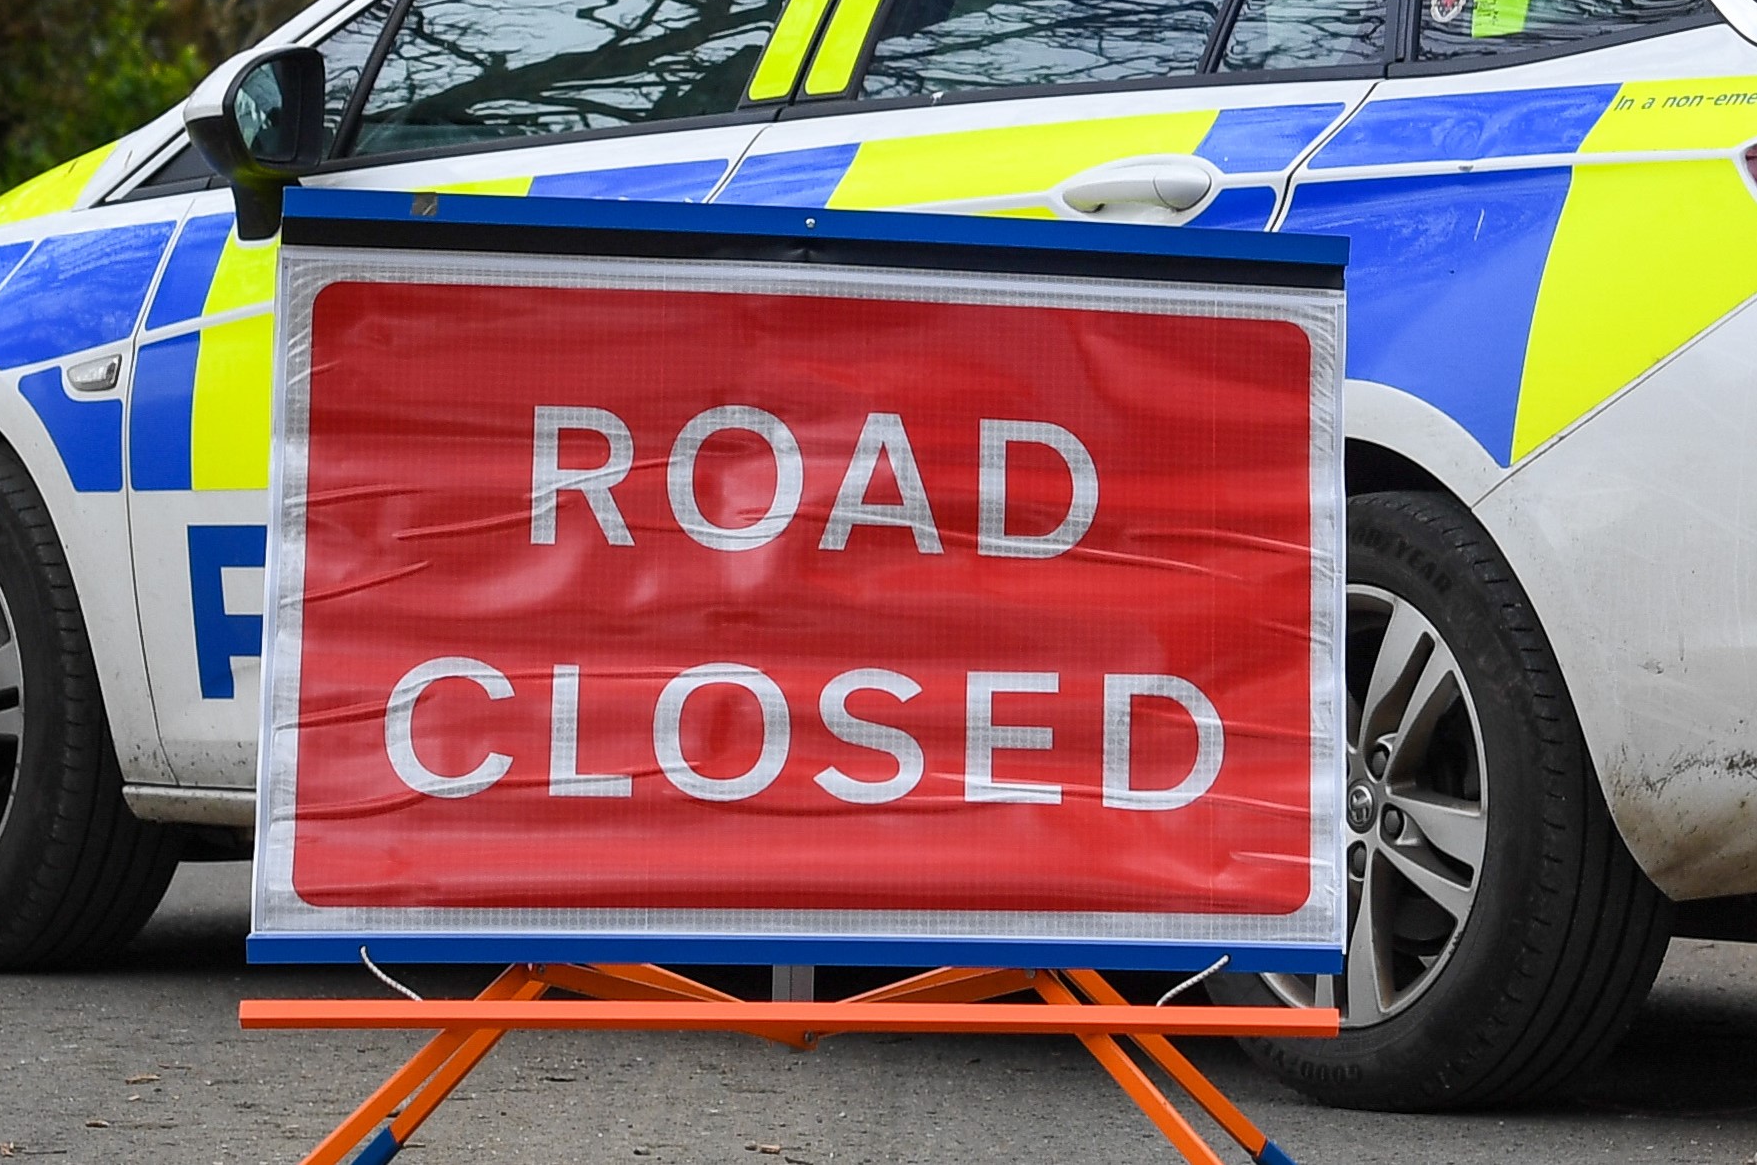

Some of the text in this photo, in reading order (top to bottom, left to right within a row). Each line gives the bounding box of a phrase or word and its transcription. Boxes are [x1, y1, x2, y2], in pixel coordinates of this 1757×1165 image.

[1613, 95, 1635, 112] In
[1641, 97, 1656, 110] a
[529, 404, 1100, 560] ROAD
[383, 655, 1226, 812] CLOSED
